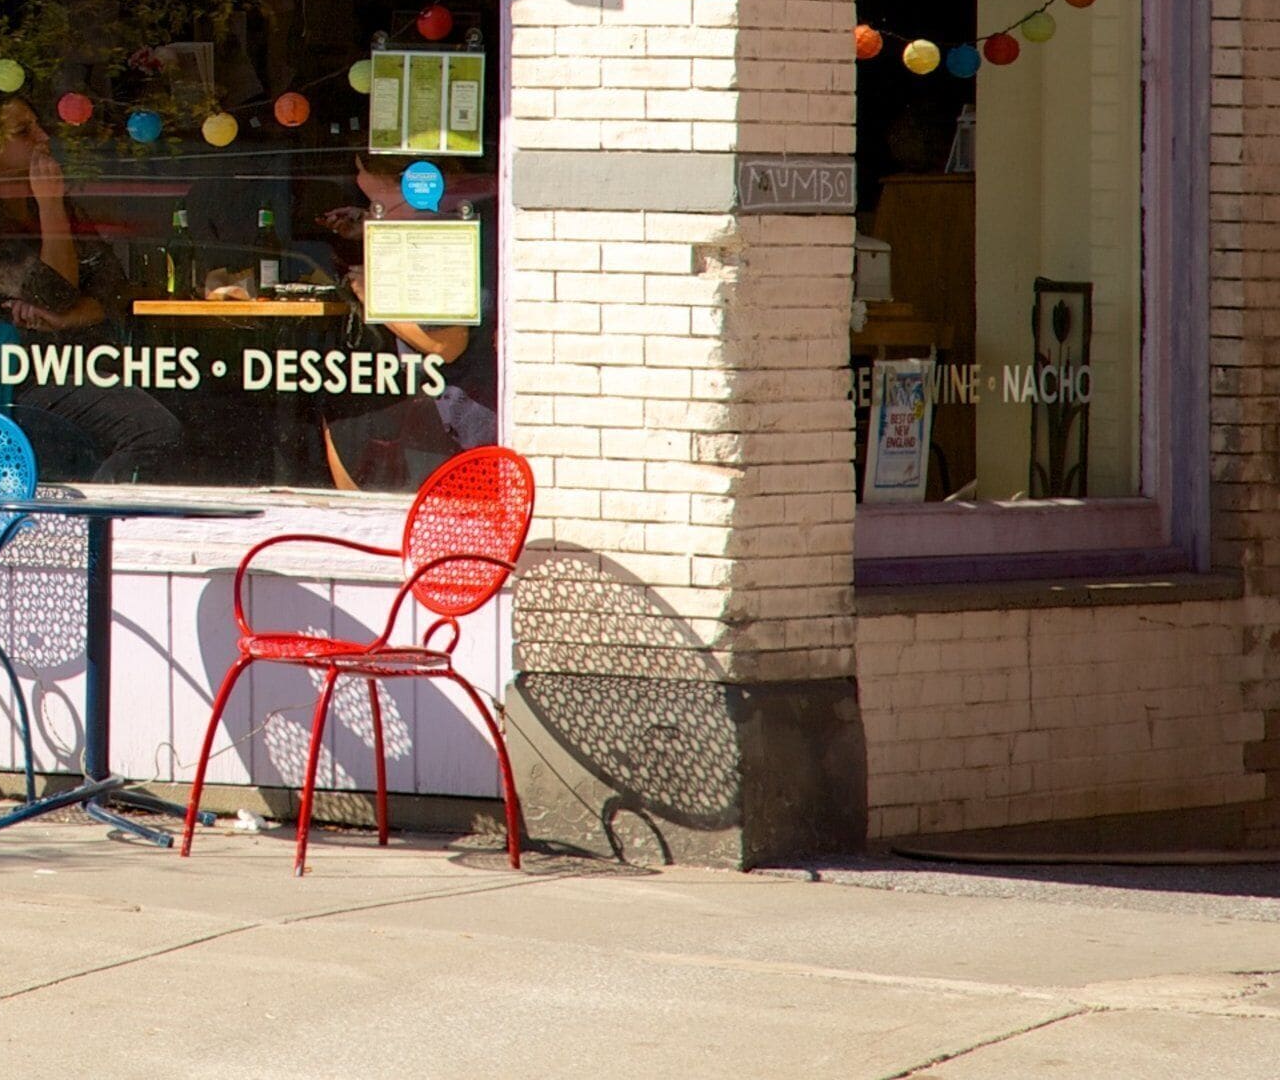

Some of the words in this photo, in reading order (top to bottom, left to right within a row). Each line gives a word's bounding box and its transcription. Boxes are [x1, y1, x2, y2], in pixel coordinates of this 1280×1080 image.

[747, 166, 848, 204] MUMBO
[243, 349, 446, 397] DESSERTS
[923, 364, 981, 405] WINE
[886, 436, 917, 448] ENGLAND
